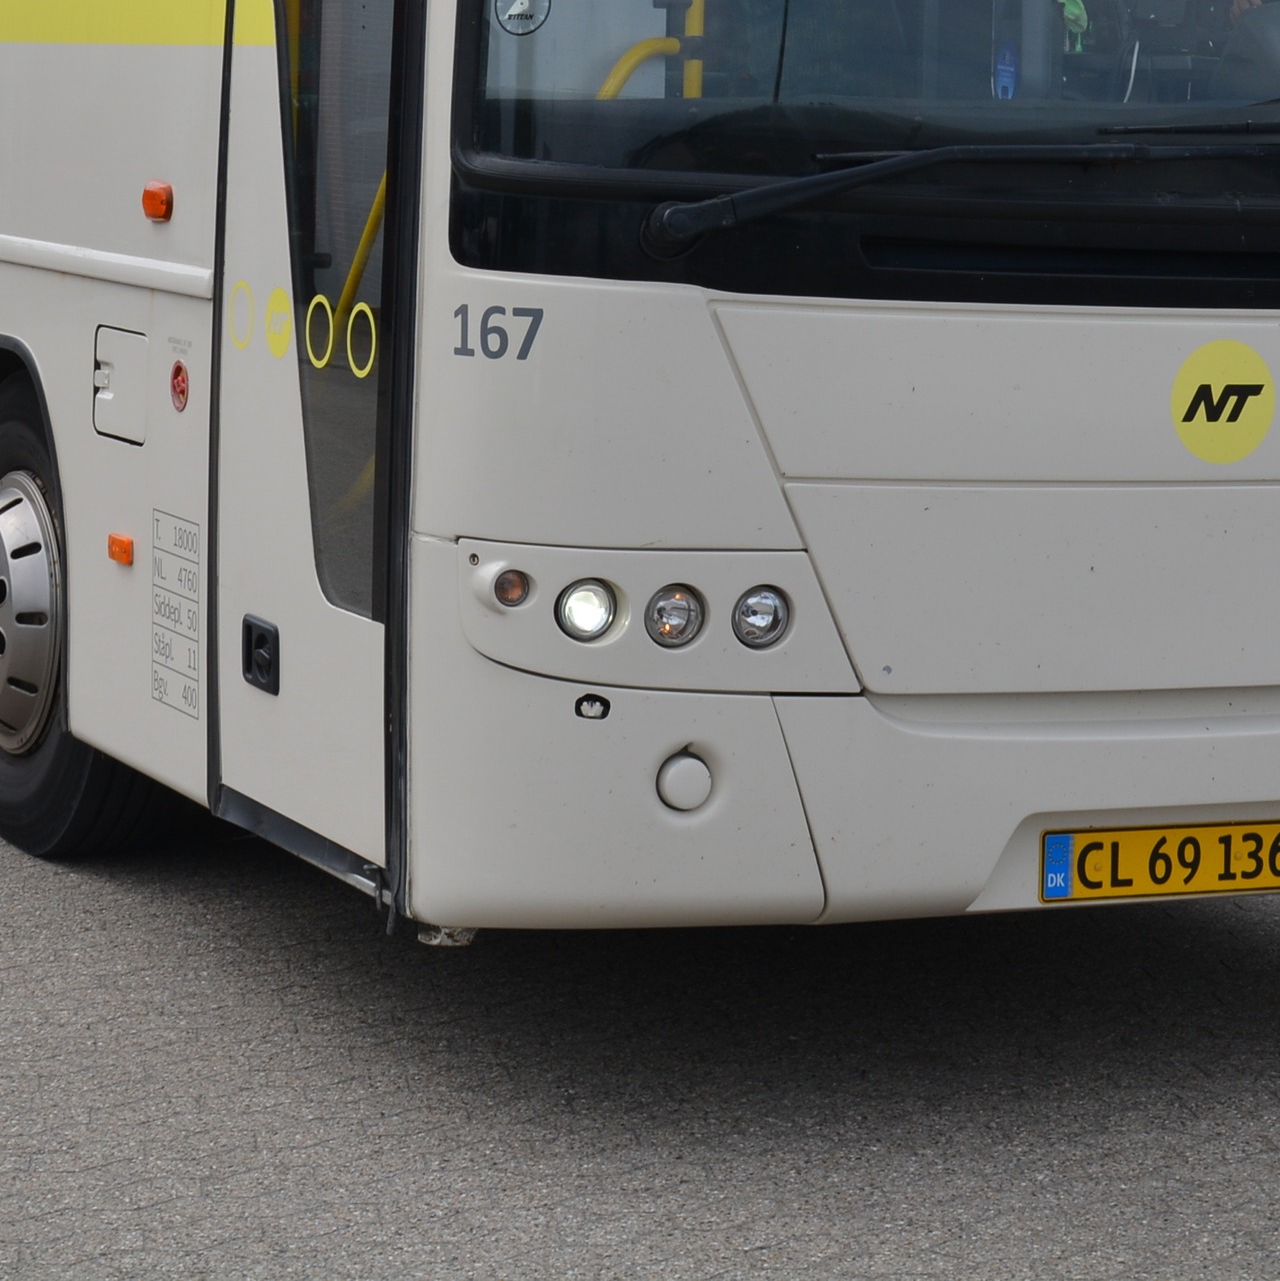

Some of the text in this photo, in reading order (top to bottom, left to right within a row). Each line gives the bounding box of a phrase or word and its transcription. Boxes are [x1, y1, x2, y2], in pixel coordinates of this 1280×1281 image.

[453, 303, 544, 361] 167
[1181, 383, 1265, 423] NT
[154, 518, 198, 554] T. 18000
[177, 567, 198, 593] 4760
[186, 609, 197, 633] 50
[187, 647, 197, 671] 11
[182, 684, 197, 709] 400
[1076, 841, 1134, 890] CL
[1148, 835, 1202, 886] 69
[1047, 873, 1066, 888] DK
